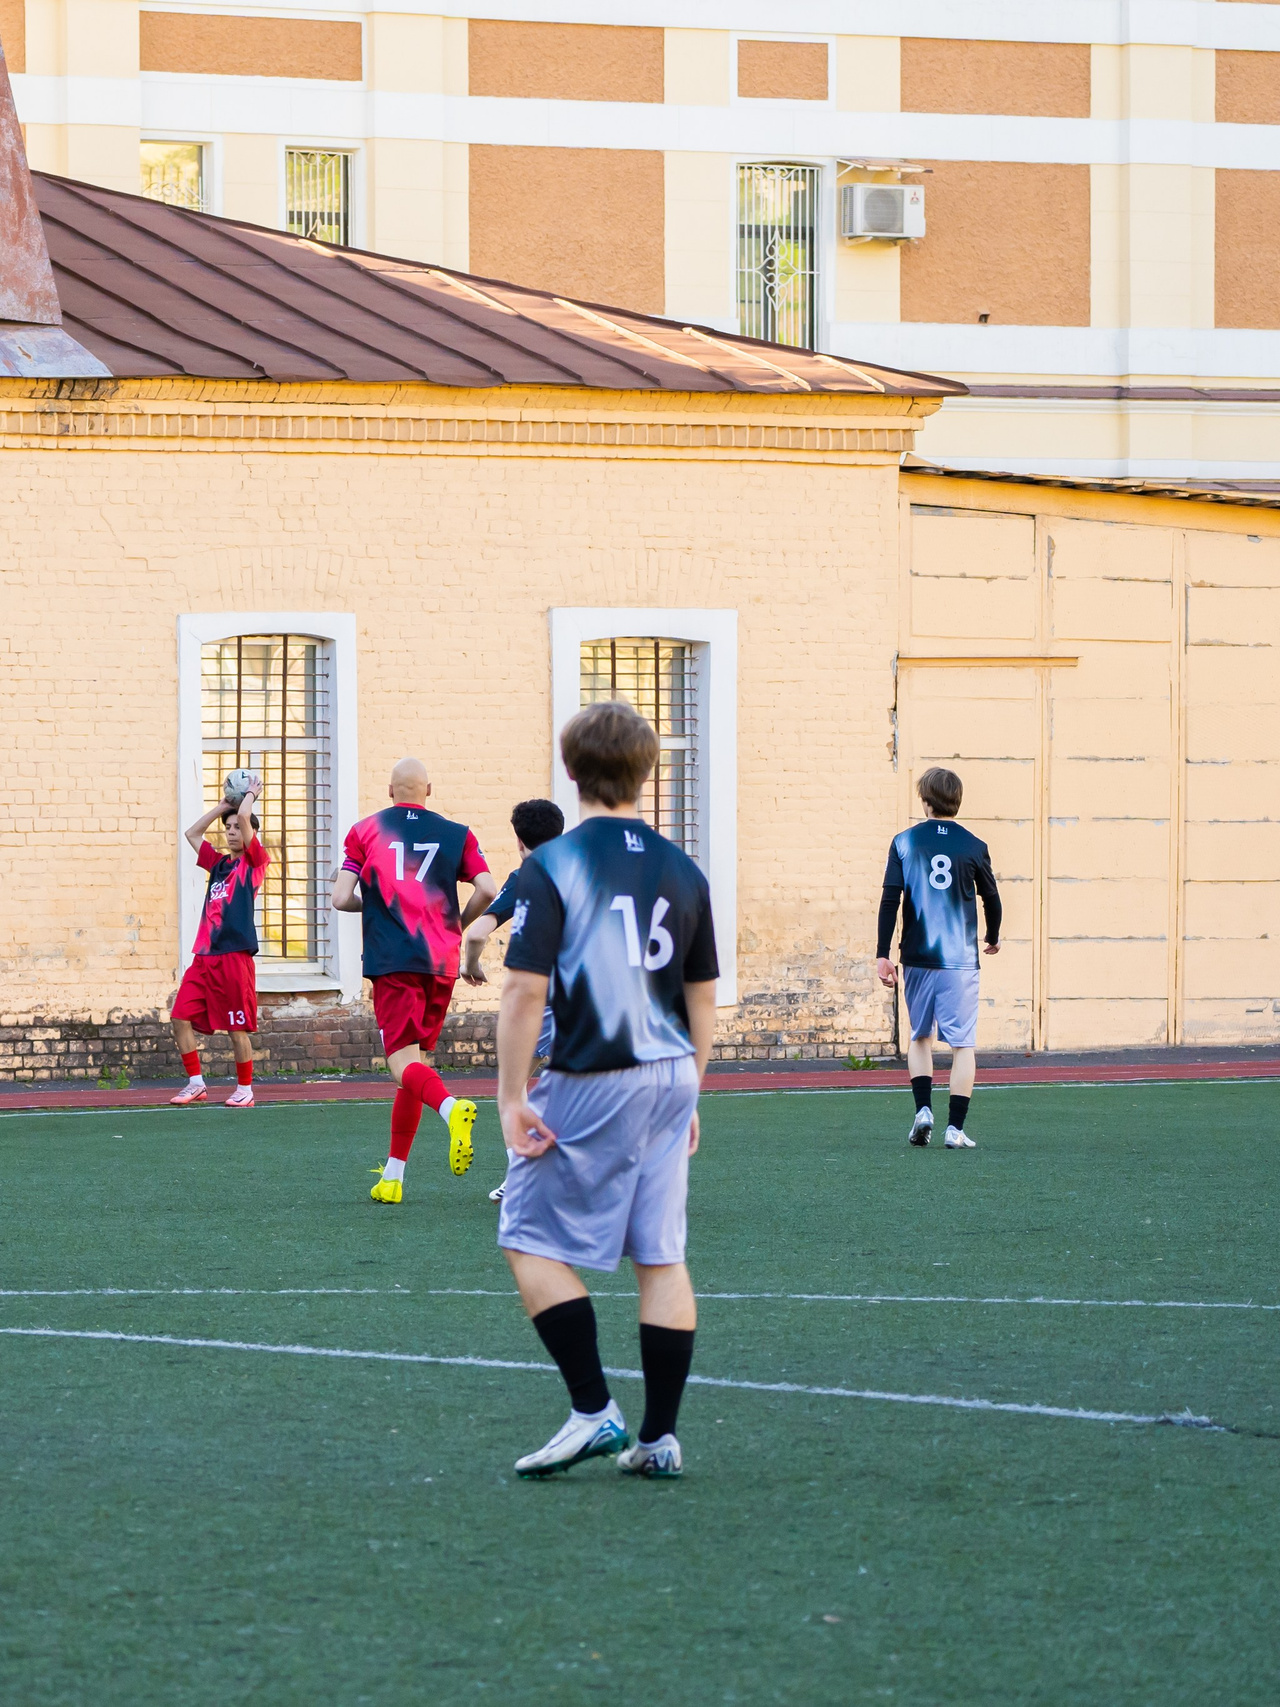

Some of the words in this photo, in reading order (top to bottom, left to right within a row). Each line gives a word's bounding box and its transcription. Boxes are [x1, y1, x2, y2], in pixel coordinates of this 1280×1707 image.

[388, 841, 440, 883] 17
[929, 854, 953, 890] 8
[609, 895, 674, 972] 16
[228, 1010, 246, 1025] 13
